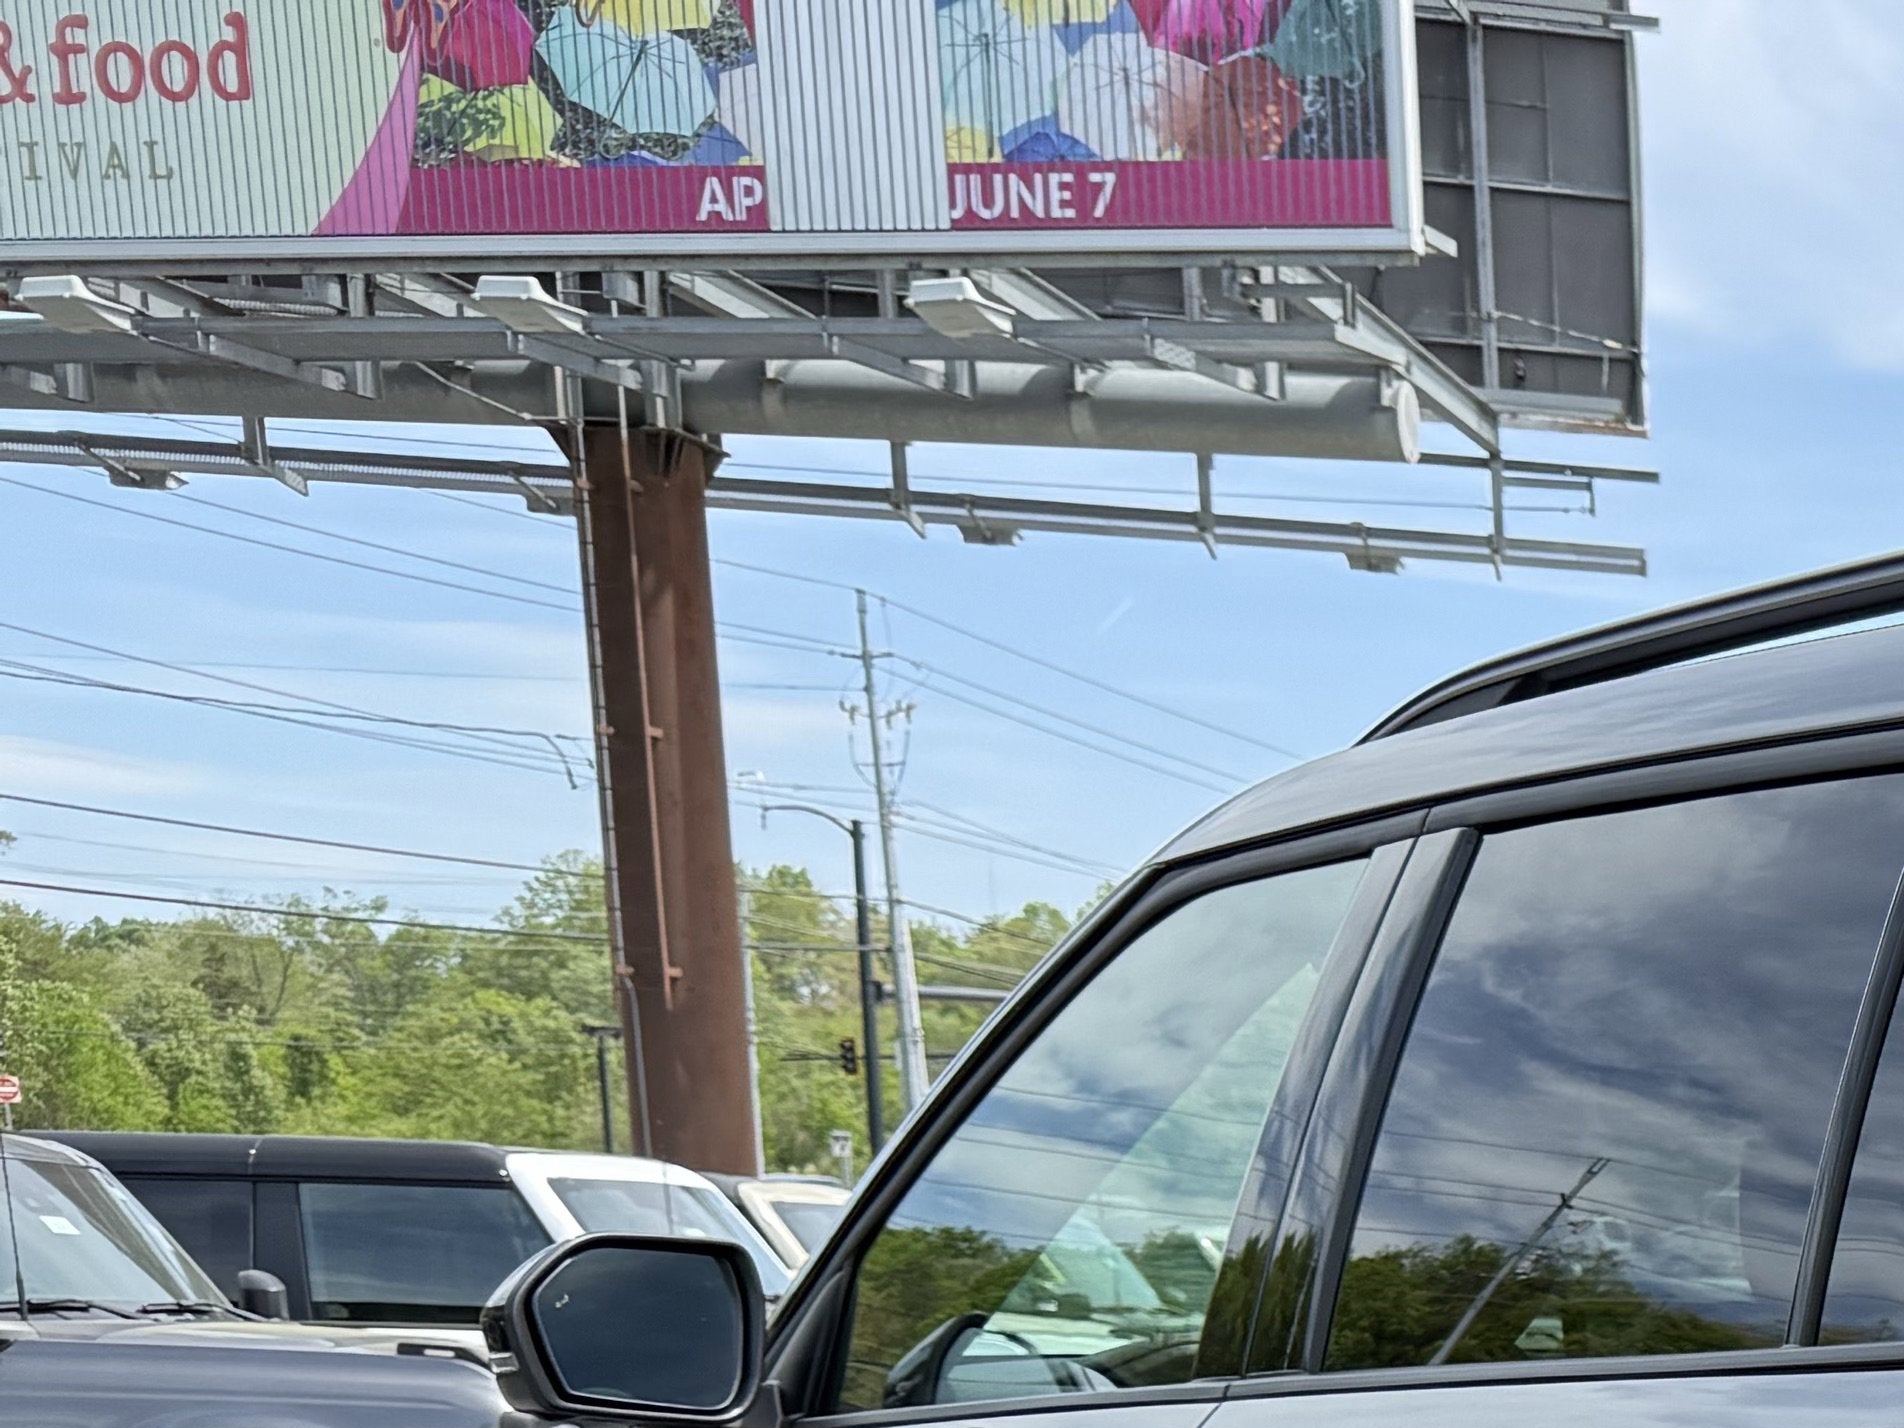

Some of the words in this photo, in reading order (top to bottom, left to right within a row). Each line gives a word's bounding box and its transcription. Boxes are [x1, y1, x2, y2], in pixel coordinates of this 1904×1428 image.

[49, 11, 251, 105] food
[0, 140, 174, 181] IVAL
[950, 172, 1077, 220] JUNE
[1087, 172, 1118, 219] 7
